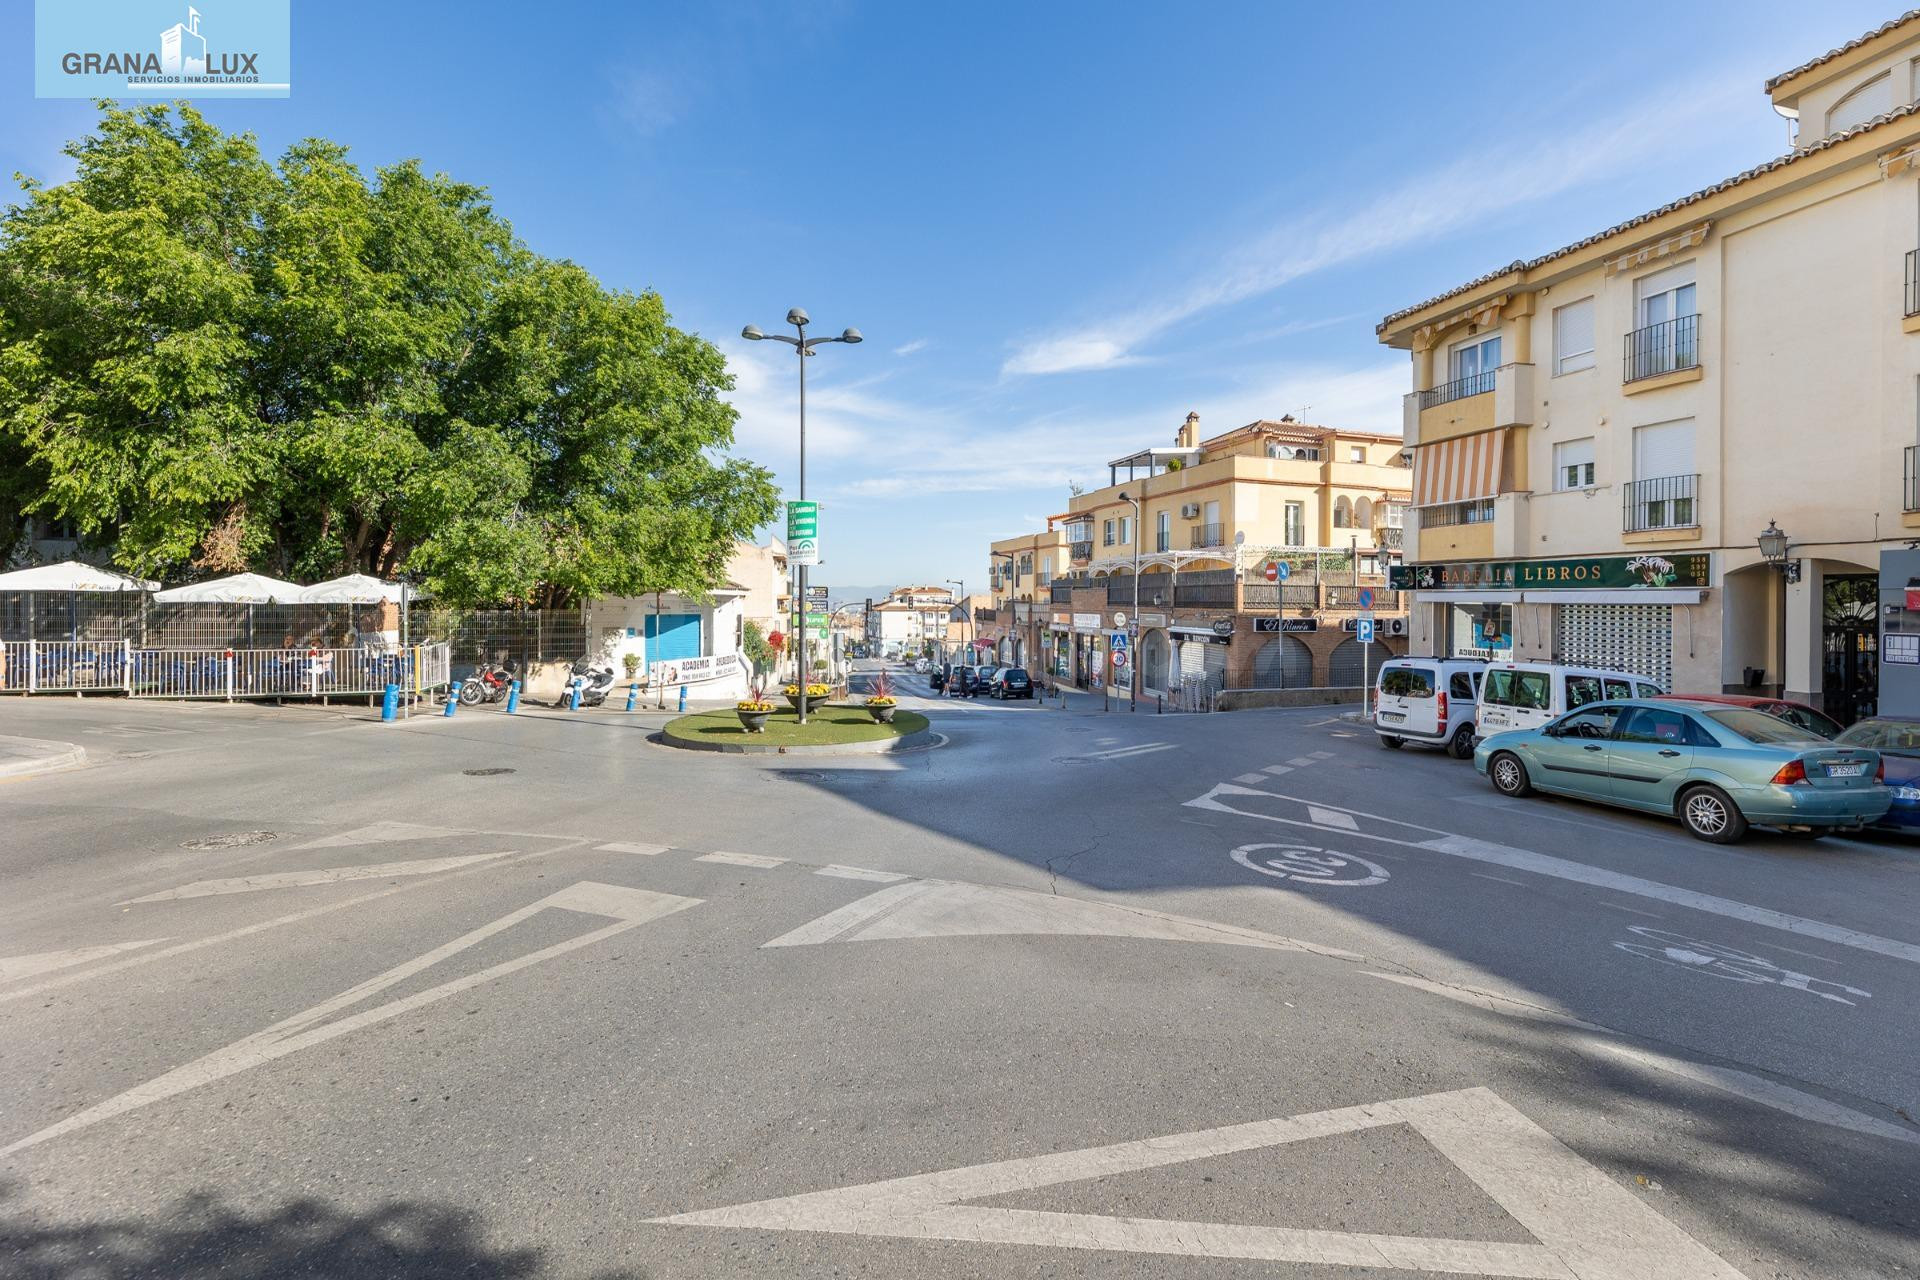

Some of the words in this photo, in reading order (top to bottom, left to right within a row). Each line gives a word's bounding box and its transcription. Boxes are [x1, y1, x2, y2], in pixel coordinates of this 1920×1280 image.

[1441, 567, 1514, 583] BABELIA
[1525, 565, 1602, 581] LIBROS
[1360, 621, 1371, 640] P
[681, 659, 710, 671] ACADEMIA
